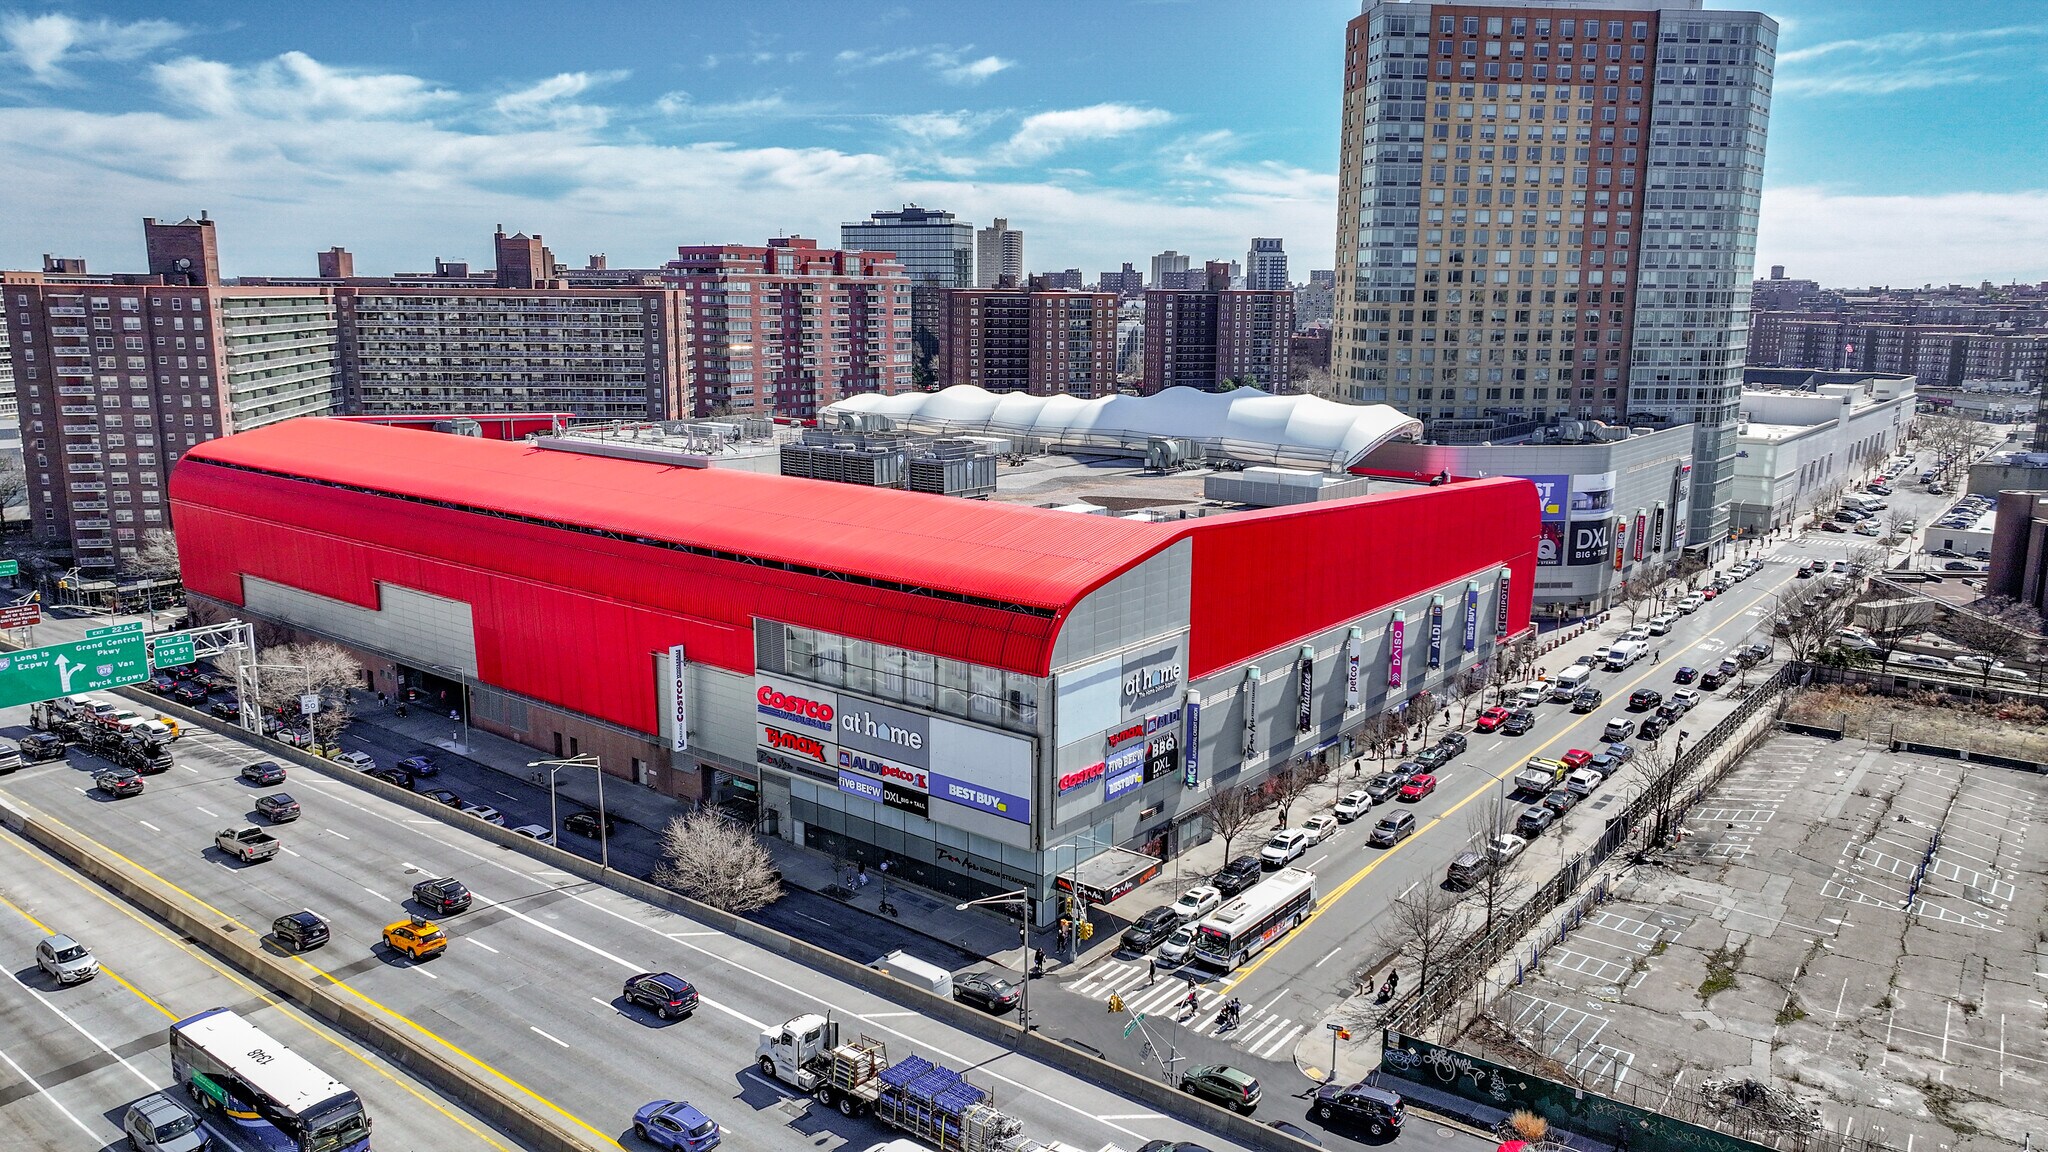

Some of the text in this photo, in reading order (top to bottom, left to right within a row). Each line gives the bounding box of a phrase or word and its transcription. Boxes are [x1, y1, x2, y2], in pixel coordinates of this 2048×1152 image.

[1576, 526, 1609, 550] DXL
[1654, 533, 1662, 547] DXL
[1575, 551, 1591, 559] BIG
[1500, 579, 1509, 620] CHIPOTLE
[111, 626, 122, 634] 22
[123, 623, 137, 631] A-E
[1466, 606, 1476, 640] BEST BUY
[75, 635, 140, 652] Grand Central
[1431, 624, 1441, 649] ALDI
[14, 652, 38, 663] Long
[97, 647, 120, 657] Pkwy
[158, 646, 189, 657] 108 St
[1393, 630, 1402, 666] DAISO
[17, 660, 49, 671] Expwy
[117, 660, 135, 668] Van
[88, 673, 145, 688] Wyck Expwy
[1124, 674, 1140, 696] at
[1350, 665, 1358, 692] petco
[676, 679, 684, 722] COSTCO
[757, 685, 834, 722] COSTCO
[1301, 671, 1311, 716] Mandee
[779, 710, 832, 732] WHOLESALE
[841, 711, 861, 734] at
[1156, 709, 1180, 730] ALDI
[1152, 735, 1175, 758] BBQ
[852, 756, 883, 776] ALDI
[881, 765, 914, 783] petco
[1153, 756, 1171, 774] DXL
[1187, 760, 1197, 784] MCU
[1058, 761, 1106, 791] COSTCO
[856, 781, 882, 797] BELOW
[948, 783, 1001, 808] BEST BUY
[1109, 779, 1125, 795] BEST
[883, 790, 902, 804] DXL
[913, 801, 926, 810] TALL
[979, 866, 1001, 878] KOREAN
[1001, 873, 1036, 890] STEAKHOUSE
[247, 1048, 275, 1065] 1348
